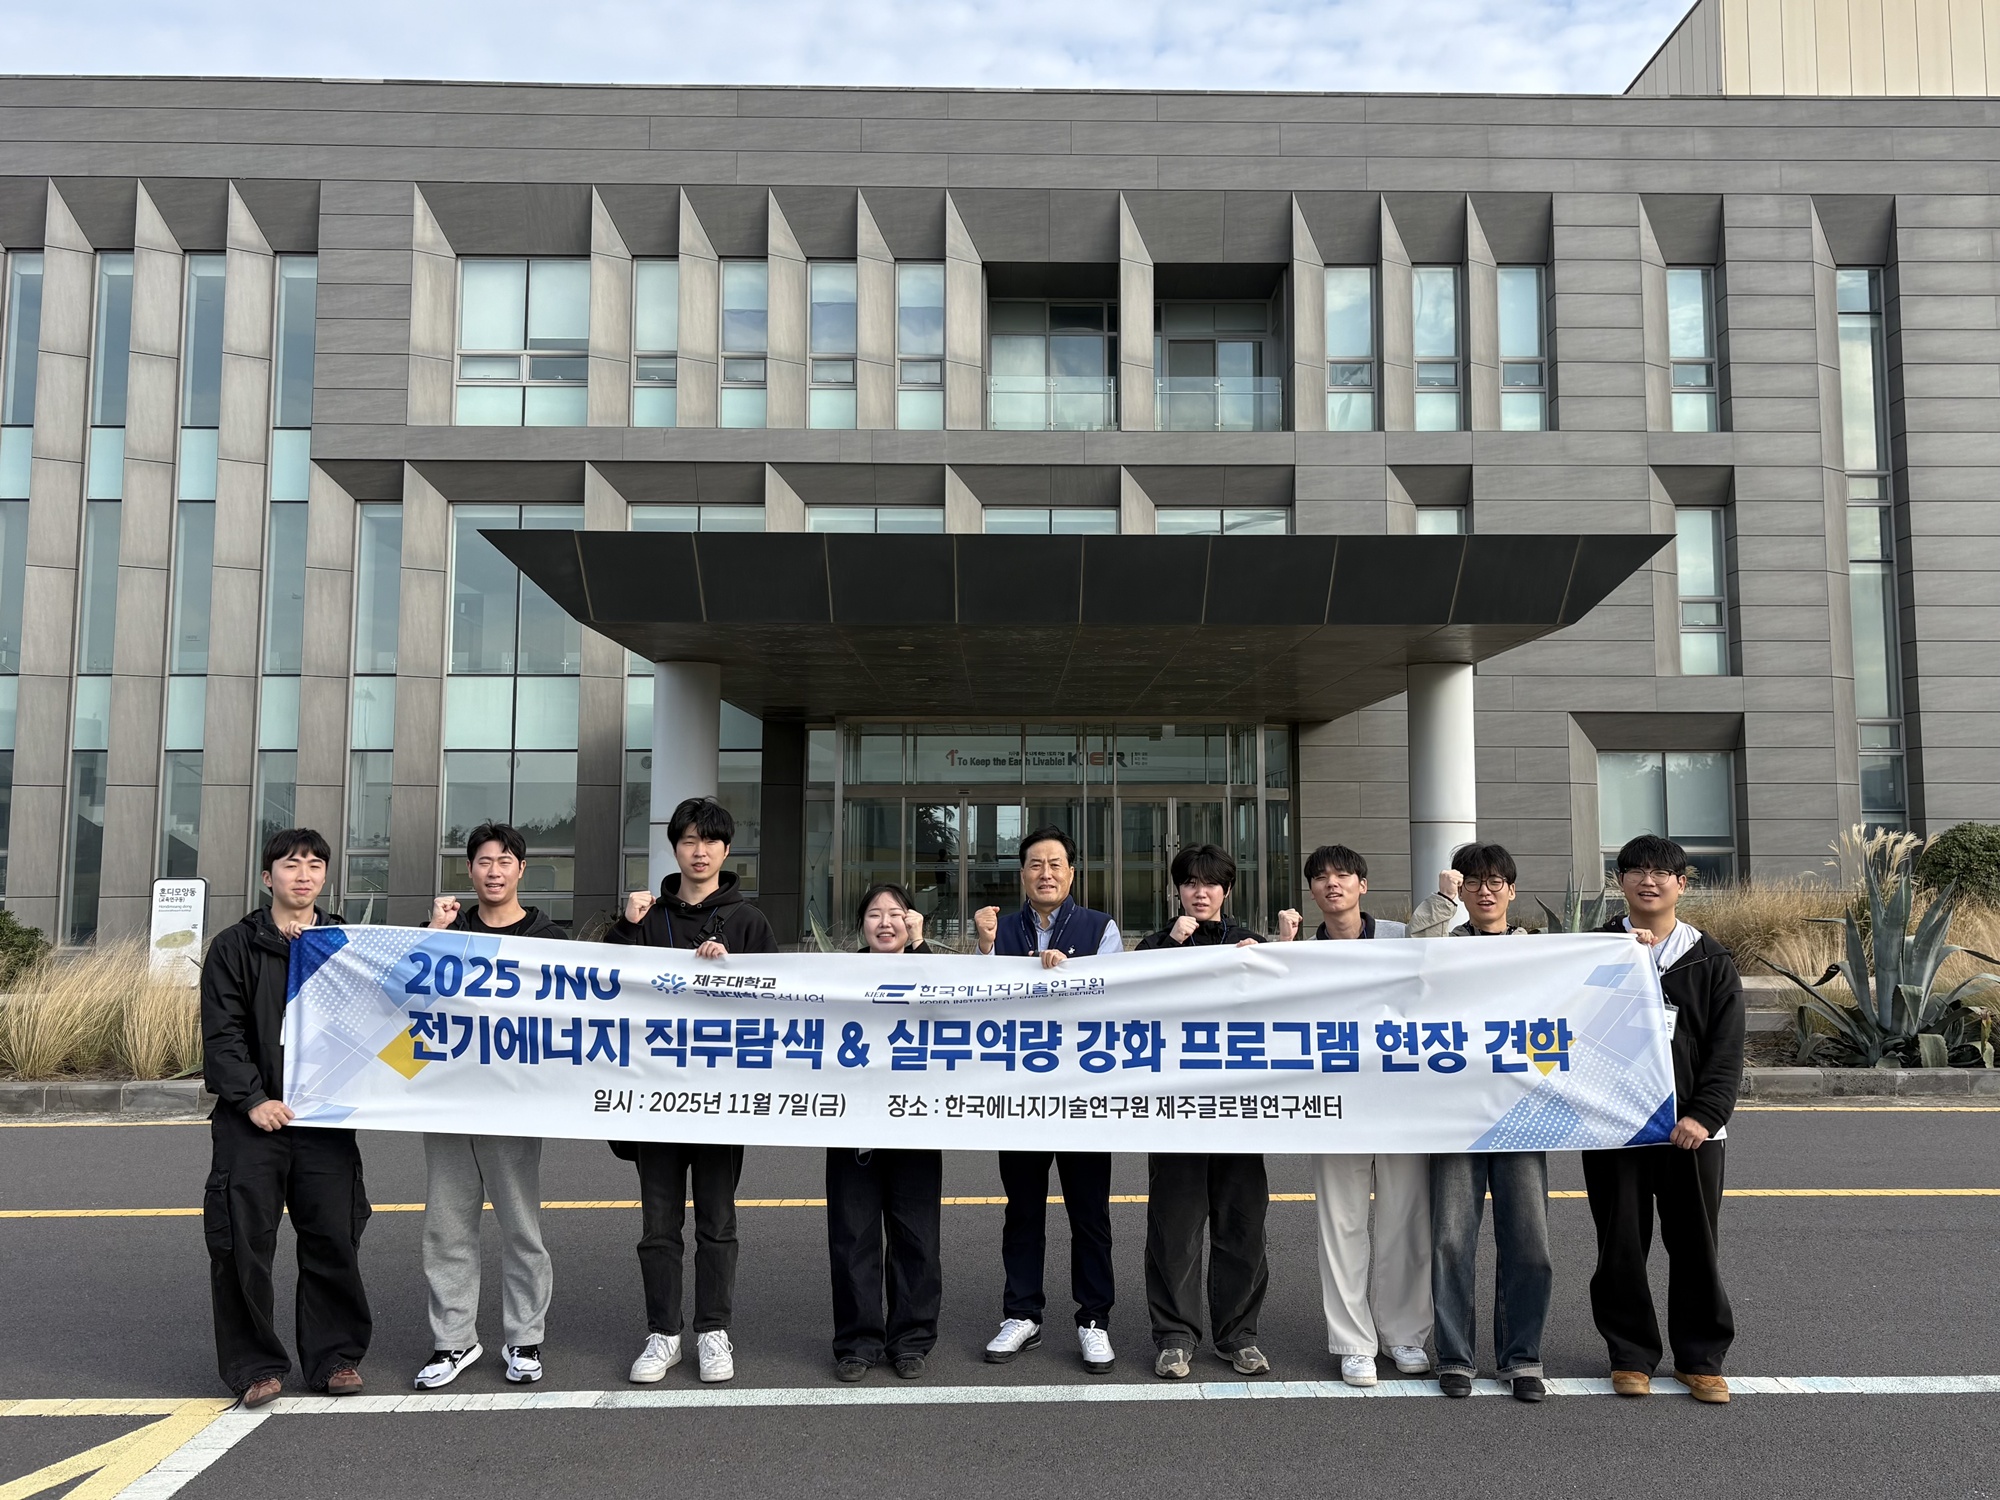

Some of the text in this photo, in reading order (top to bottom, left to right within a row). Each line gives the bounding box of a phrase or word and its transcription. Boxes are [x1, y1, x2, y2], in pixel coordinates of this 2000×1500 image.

[957, 757, 968, 766] To
[970, 757, 990, 768] Keep
[993, 757, 1006, 766] the
[1008, 757, 1031, 766] Earh
[1032, 757, 1065, 766] Livable!
[159, 887, 197, 897] 혼디모앙동
[404, 952, 622, 1001] 2025 JNU
[692, 974, 777, 989] 제주대학교
[919, 977, 1105, 999] 한국에너지기술연구원
[408, 1010, 1573, 1074] 전기에너지 직무탐색 & 실무역량 강화 프로그램 현장 견학
[593, 1089, 633, 1114] 일시
[649, 1091, 722, 1115] 2025년
[727, 1092, 772, 1116] 11월
[778, 1093, 847, 1118] 7일(금)
[887, 1094, 928, 1118] 장소
[945, 1094, 1150, 1120] 한국에너지기술연구원
[1155, 1094, 1343, 1120] 제주글로벌연구센터
